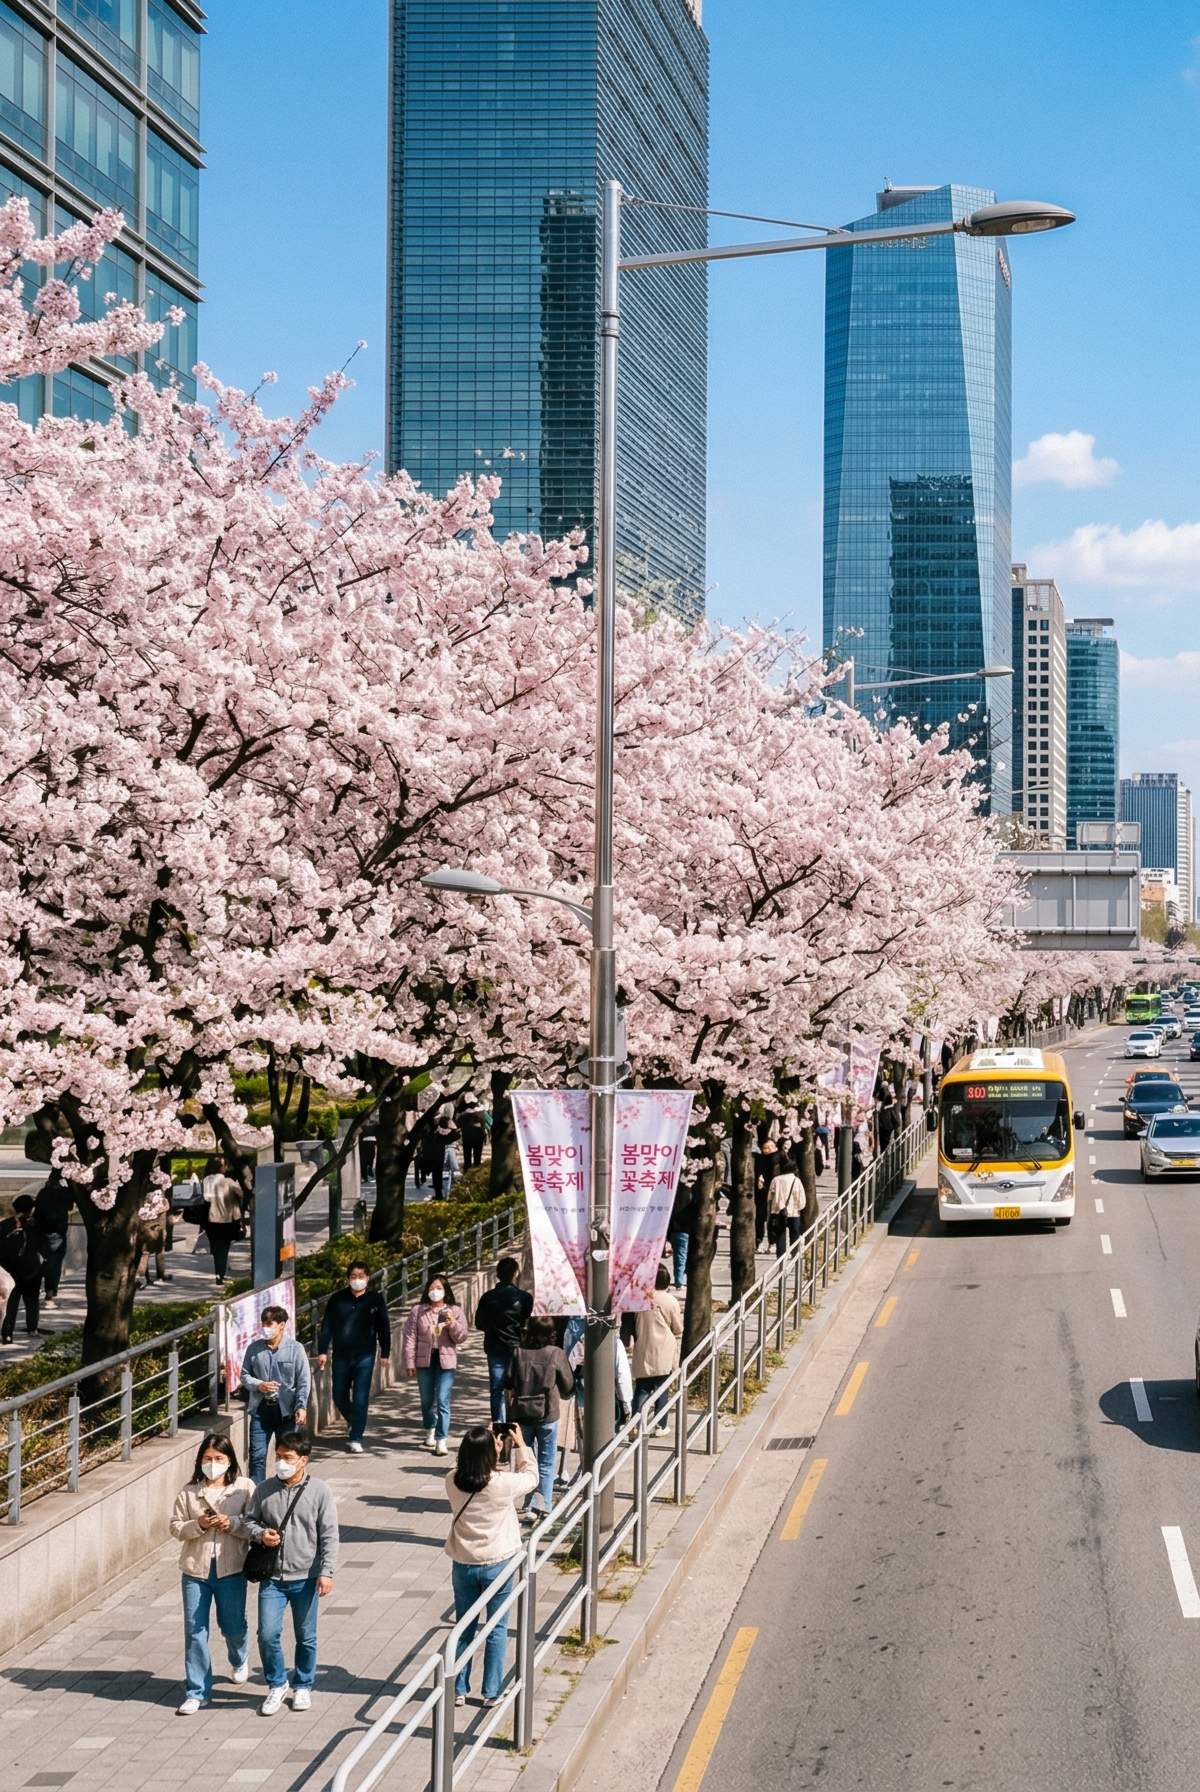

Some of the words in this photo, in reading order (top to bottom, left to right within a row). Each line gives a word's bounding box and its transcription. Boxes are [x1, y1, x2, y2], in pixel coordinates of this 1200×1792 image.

[525, 1144, 583, 1167] 봄맞이
[620, 1143, 678, 1167] 봄맞이
[529, 1170, 584, 1194] 꽃축제
[619, 1169, 675, 1193] 꽃축제
